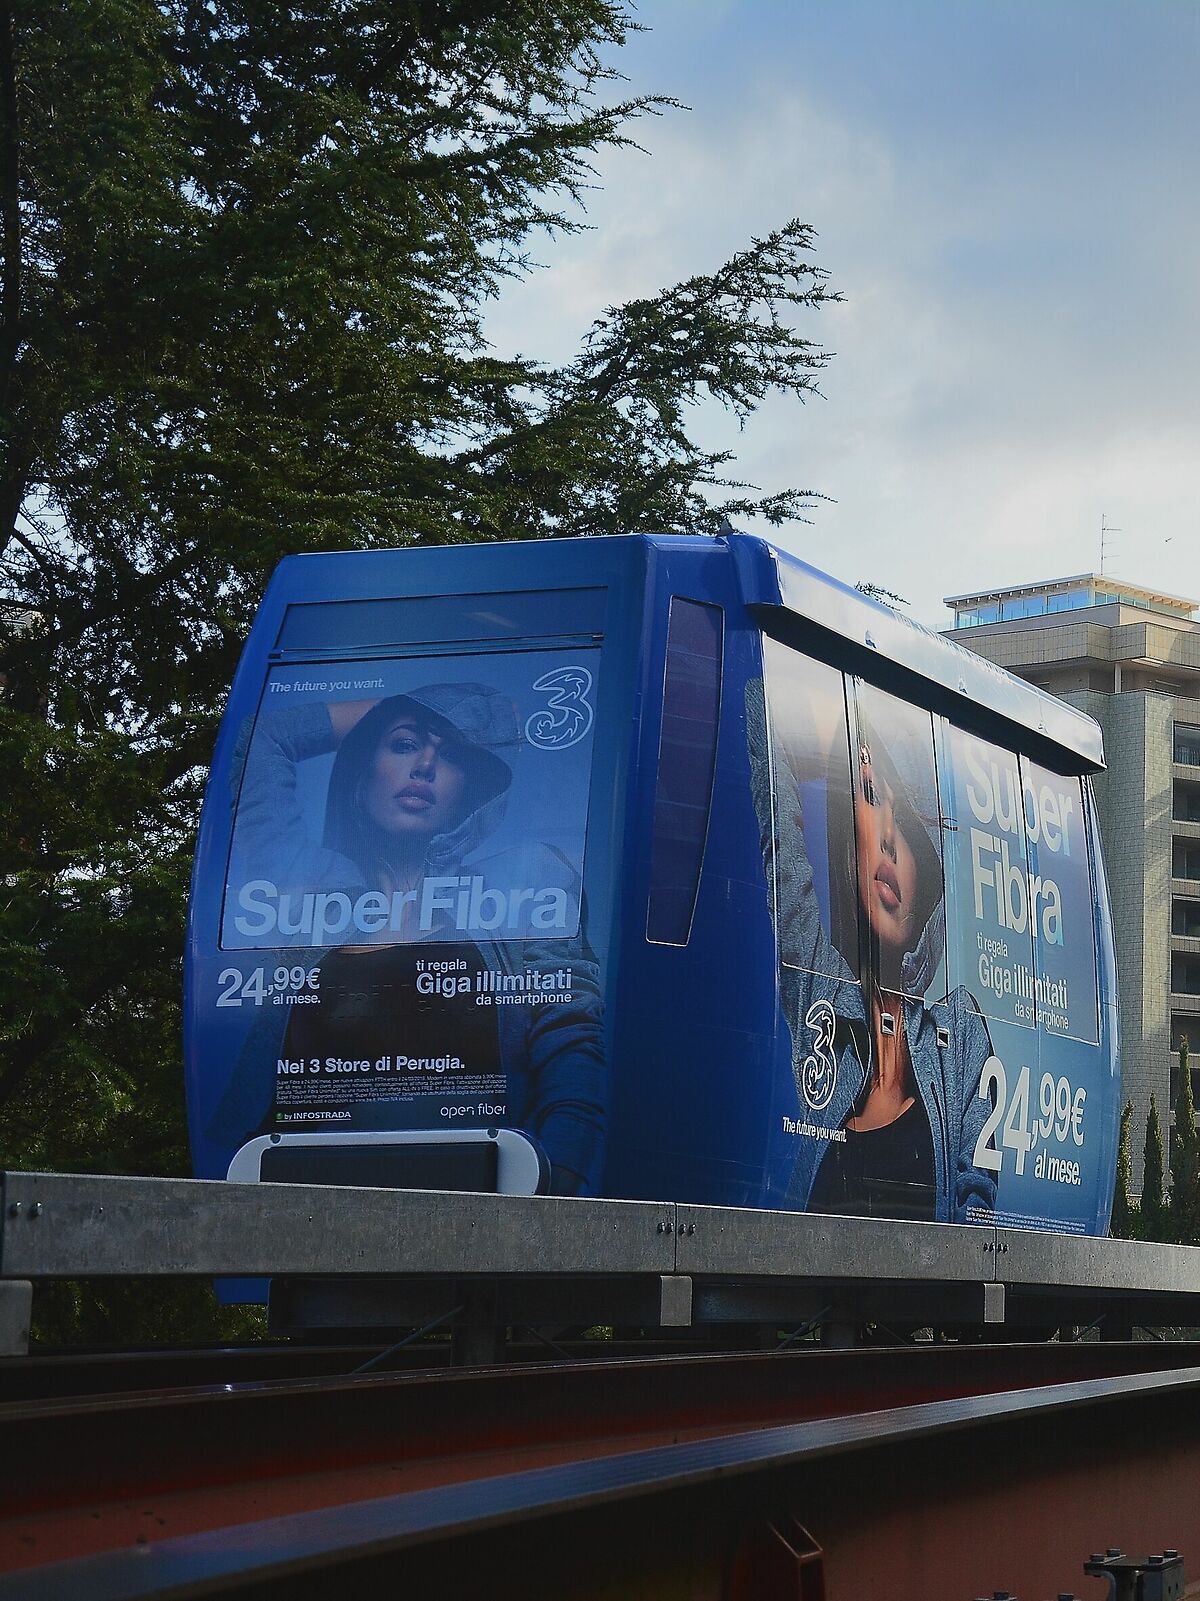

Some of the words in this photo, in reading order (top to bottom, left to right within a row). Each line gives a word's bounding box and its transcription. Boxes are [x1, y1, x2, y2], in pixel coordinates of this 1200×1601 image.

[270, 682, 290, 692] The
[294, 680, 326, 692] future
[329, 680, 351, 691] you
[353, 678, 385, 690] want.
[967, 752, 1072, 859] Super
[970, 828, 1064, 946] Fibra
[976, 934, 983, 949] ti
[984, 937, 1008, 959] regala
[416, 960, 425, 971] ti
[427, 959, 467, 973] regala
[416, 973, 471, 997] Giga
[476, 968, 571, 992] illimitati
[978, 954, 1011, 998] Giga
[273, 993, 283, 1005] al
[285, 993, 321, 1004] mese.
[476, 994, 493, 1005] da
[495, 991, 571, 1006] smartphone
[1015, 1004, 1024, 1018] da
[276, 1059, 304, 1074] Nei
[310, 1059, 320, 1072] 3
[325, 1057, 371, 1072] Store
[375, 1056, 390, 1071] di
[396, 1055, 464, 1073] Perugia.
[284, 1113, 292, 1121] by
[294, 1111, 351, 1119] INFOSTRADA
[440, 1106, 475, 1118] open
[477, 1103, 506, 1115] fiber
[783, 1117, 796, 1133] The
[796, 1120, 816, 1138] future
[816, 1124, 829, 1141] you
[1035, 1150, 1045, 1179] al
[1048, 1158, 1081, 1185] mese.
